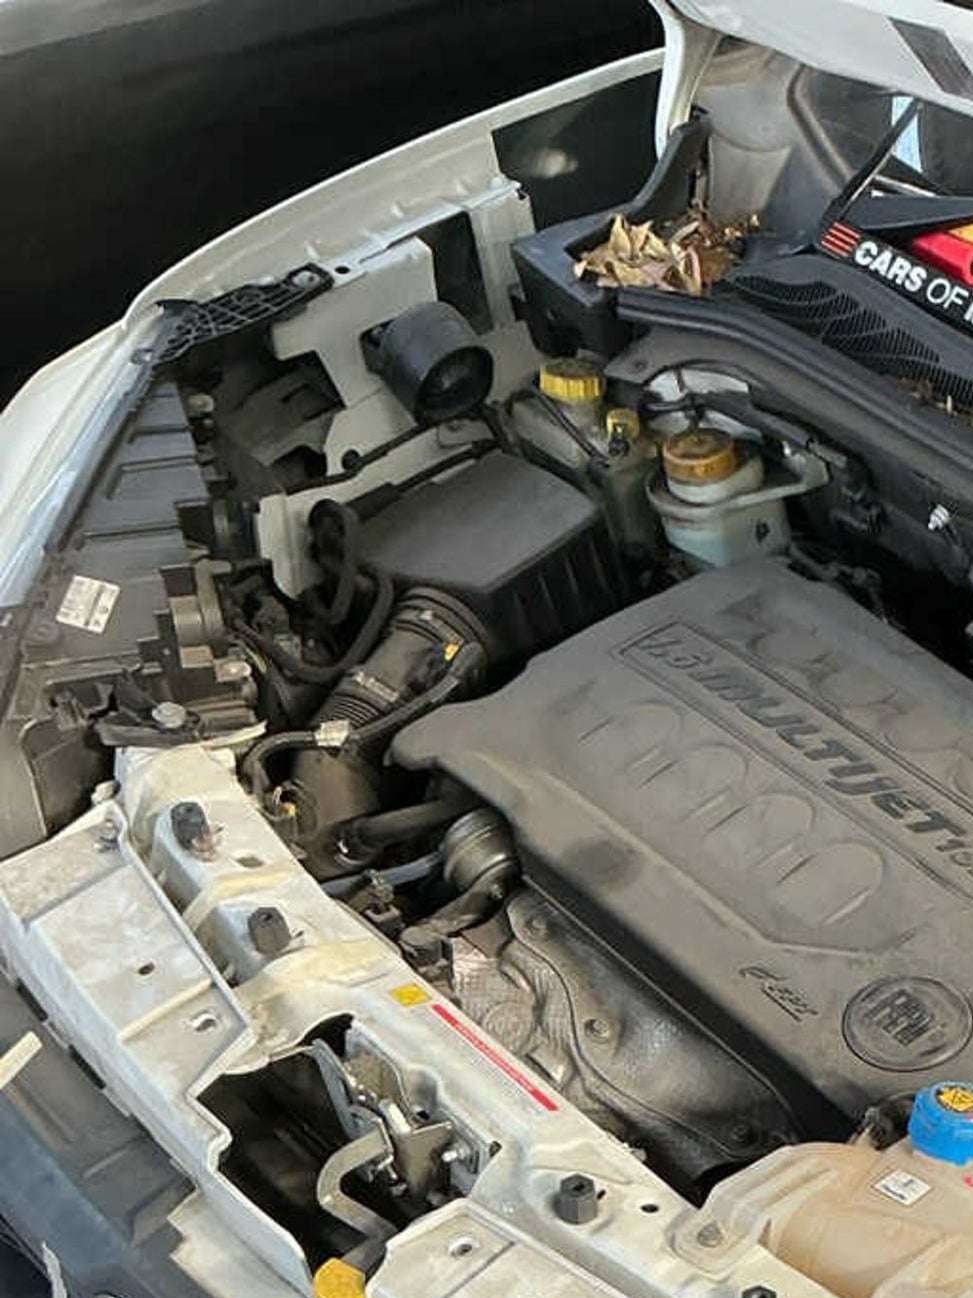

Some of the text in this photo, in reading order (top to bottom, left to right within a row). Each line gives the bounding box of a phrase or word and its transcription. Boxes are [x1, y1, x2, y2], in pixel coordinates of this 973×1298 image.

[854, 241, 928, 293] CARS
[926, 277, 969, 310] OF
[687, 667, 967, 837] MULTIJET
